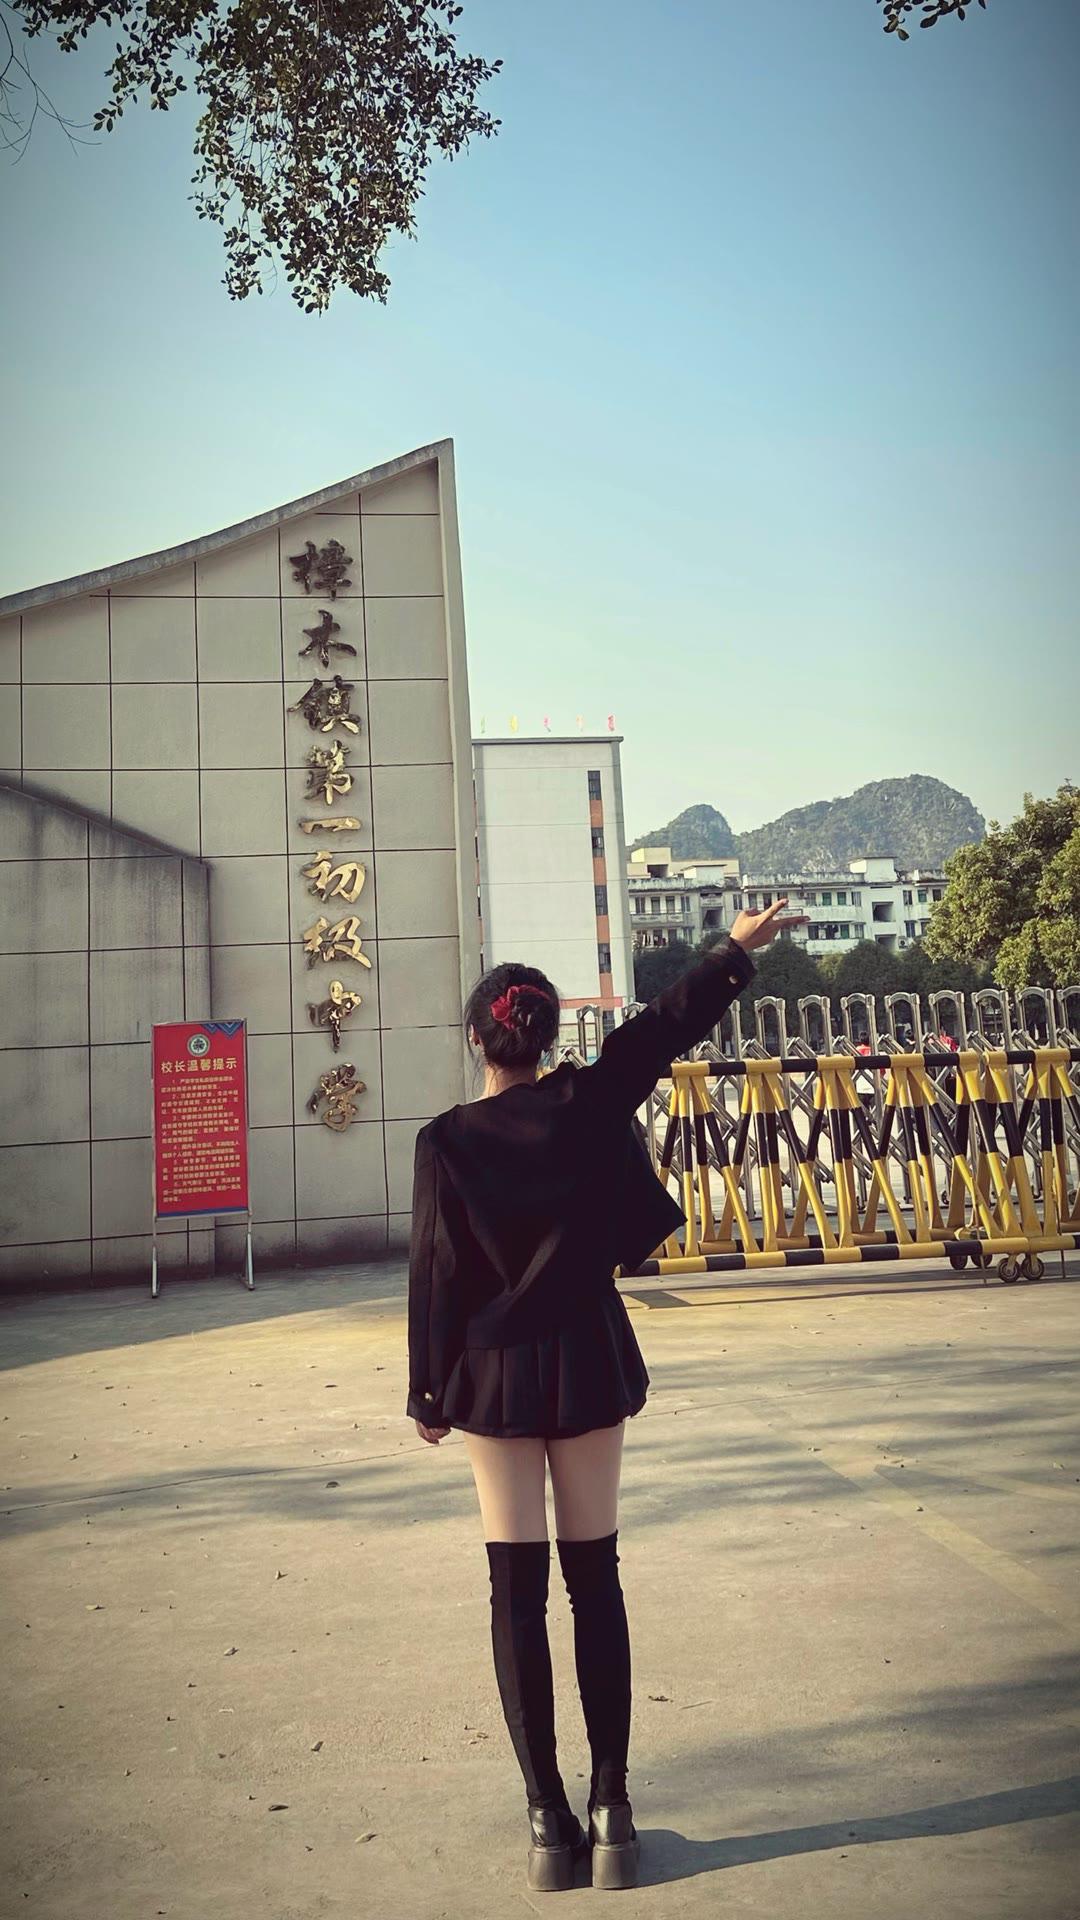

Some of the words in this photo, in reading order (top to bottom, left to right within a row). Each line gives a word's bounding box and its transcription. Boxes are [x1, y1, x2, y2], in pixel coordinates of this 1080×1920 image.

[161, 1058, 237, 1073] 校长温馨提示
